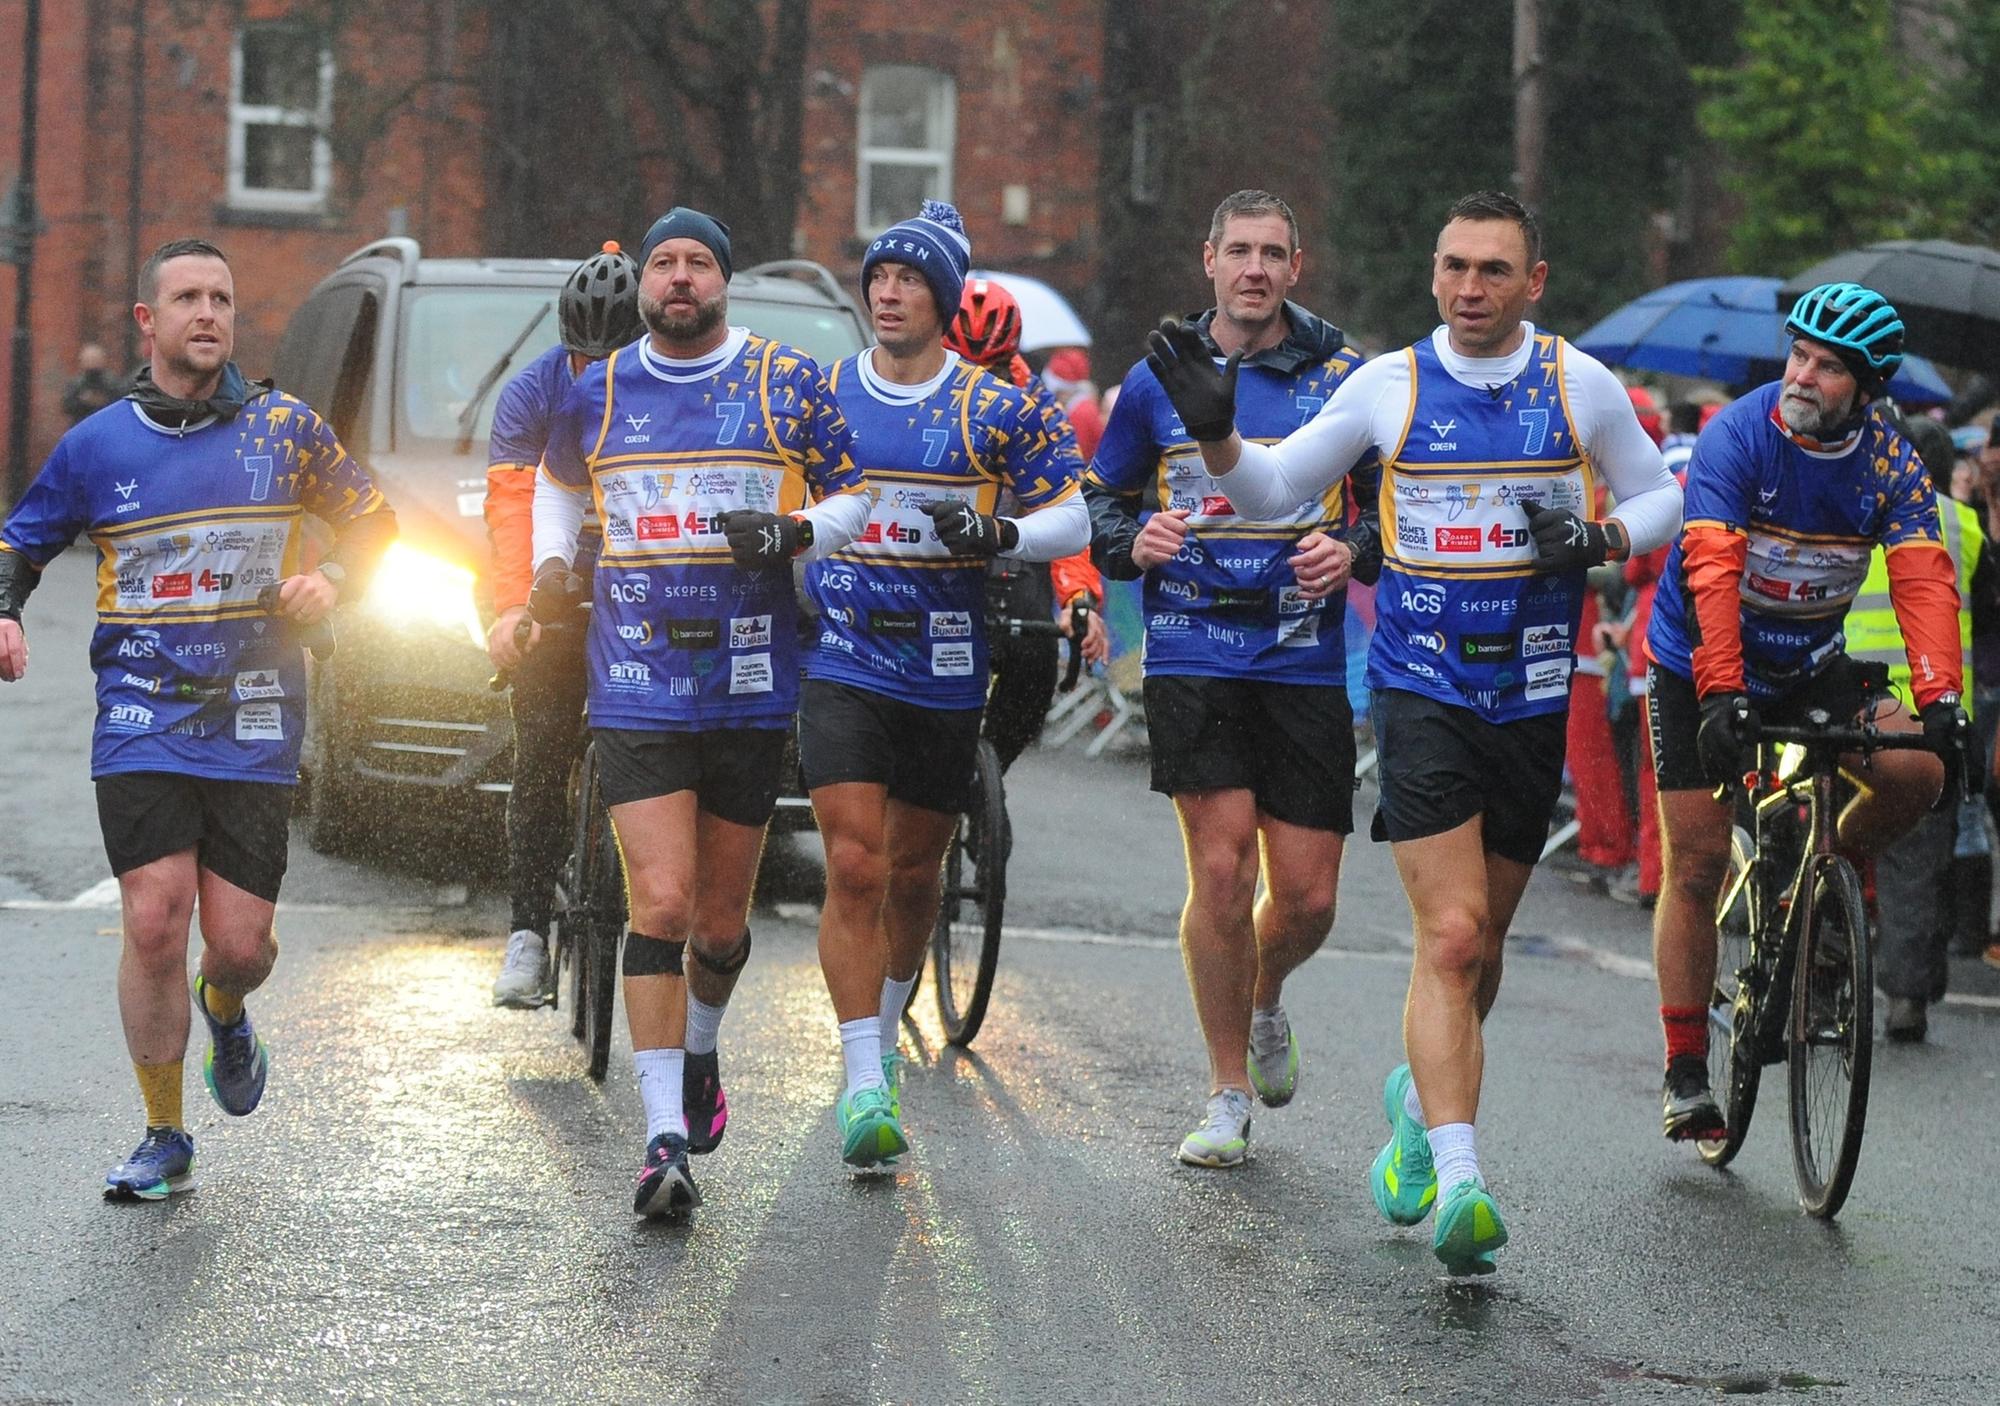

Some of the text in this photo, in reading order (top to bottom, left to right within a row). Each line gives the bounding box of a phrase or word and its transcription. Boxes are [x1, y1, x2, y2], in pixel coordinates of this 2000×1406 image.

[872, 239, 930, 260] OXEN
[715, 402, 746, 445] 7
[1518, 408, 1549, 456] 7
[624, 435, 650, 444] OXEN
[922, 429, 949, 467] 7
[1429, 442, 1457, 451] OXEN
[243, 455, 273, 501] 7
[657, 474, 675, 498] 7
[702, 473, 724, 481] Leeds
[708, 487, 735, 496] Charity
[1462, 484, 1481, 510] 7
[1514, 491, 1546, 499] Hospitals
[116, 501, 141, 513] OXEN
[684, 512, 724, 536] 4ED
[886, 522, 921, 544] 4ED
[1398, 523, 1426, 536] NAME'S
[219, 530, 242, 538] Leeds
[1398, 532, 1428, 545] DODDIE
[1487, 523, 1529, 549] 4ED
[223, 542, 251, 552] Charity
[1172, 544, 1204, 565] CS
[255, 568, 275, 577] MND
[1216, 558, 1270, 569] SKOPES
[198, 569, 234, 593] 4ED
[820, 571, 853, 592] ACS
[869, 582, 918, 595] SKOPES
[1160, 580, 1192, 598] NDA
[610, 583, 647, 602] ACS
[665, 585, 718, 598] SKOPES
[1401, 591, 1442, 614] ACS
[1461, 600, 1518, 613] SKOPES
[1207, 623, 1245, 648] EUAN'S
[1758, 631, 1811, 645] SKOPES
[118, 638, 156, 658] ACS
[175, 642, 226, 657] SKOPES
[609, 664, 651, 681] amt
[121, 673, 155, 692] NDA
[109, 704, 155, 724] amt
[170, 719, 206, 738] UAN'S
